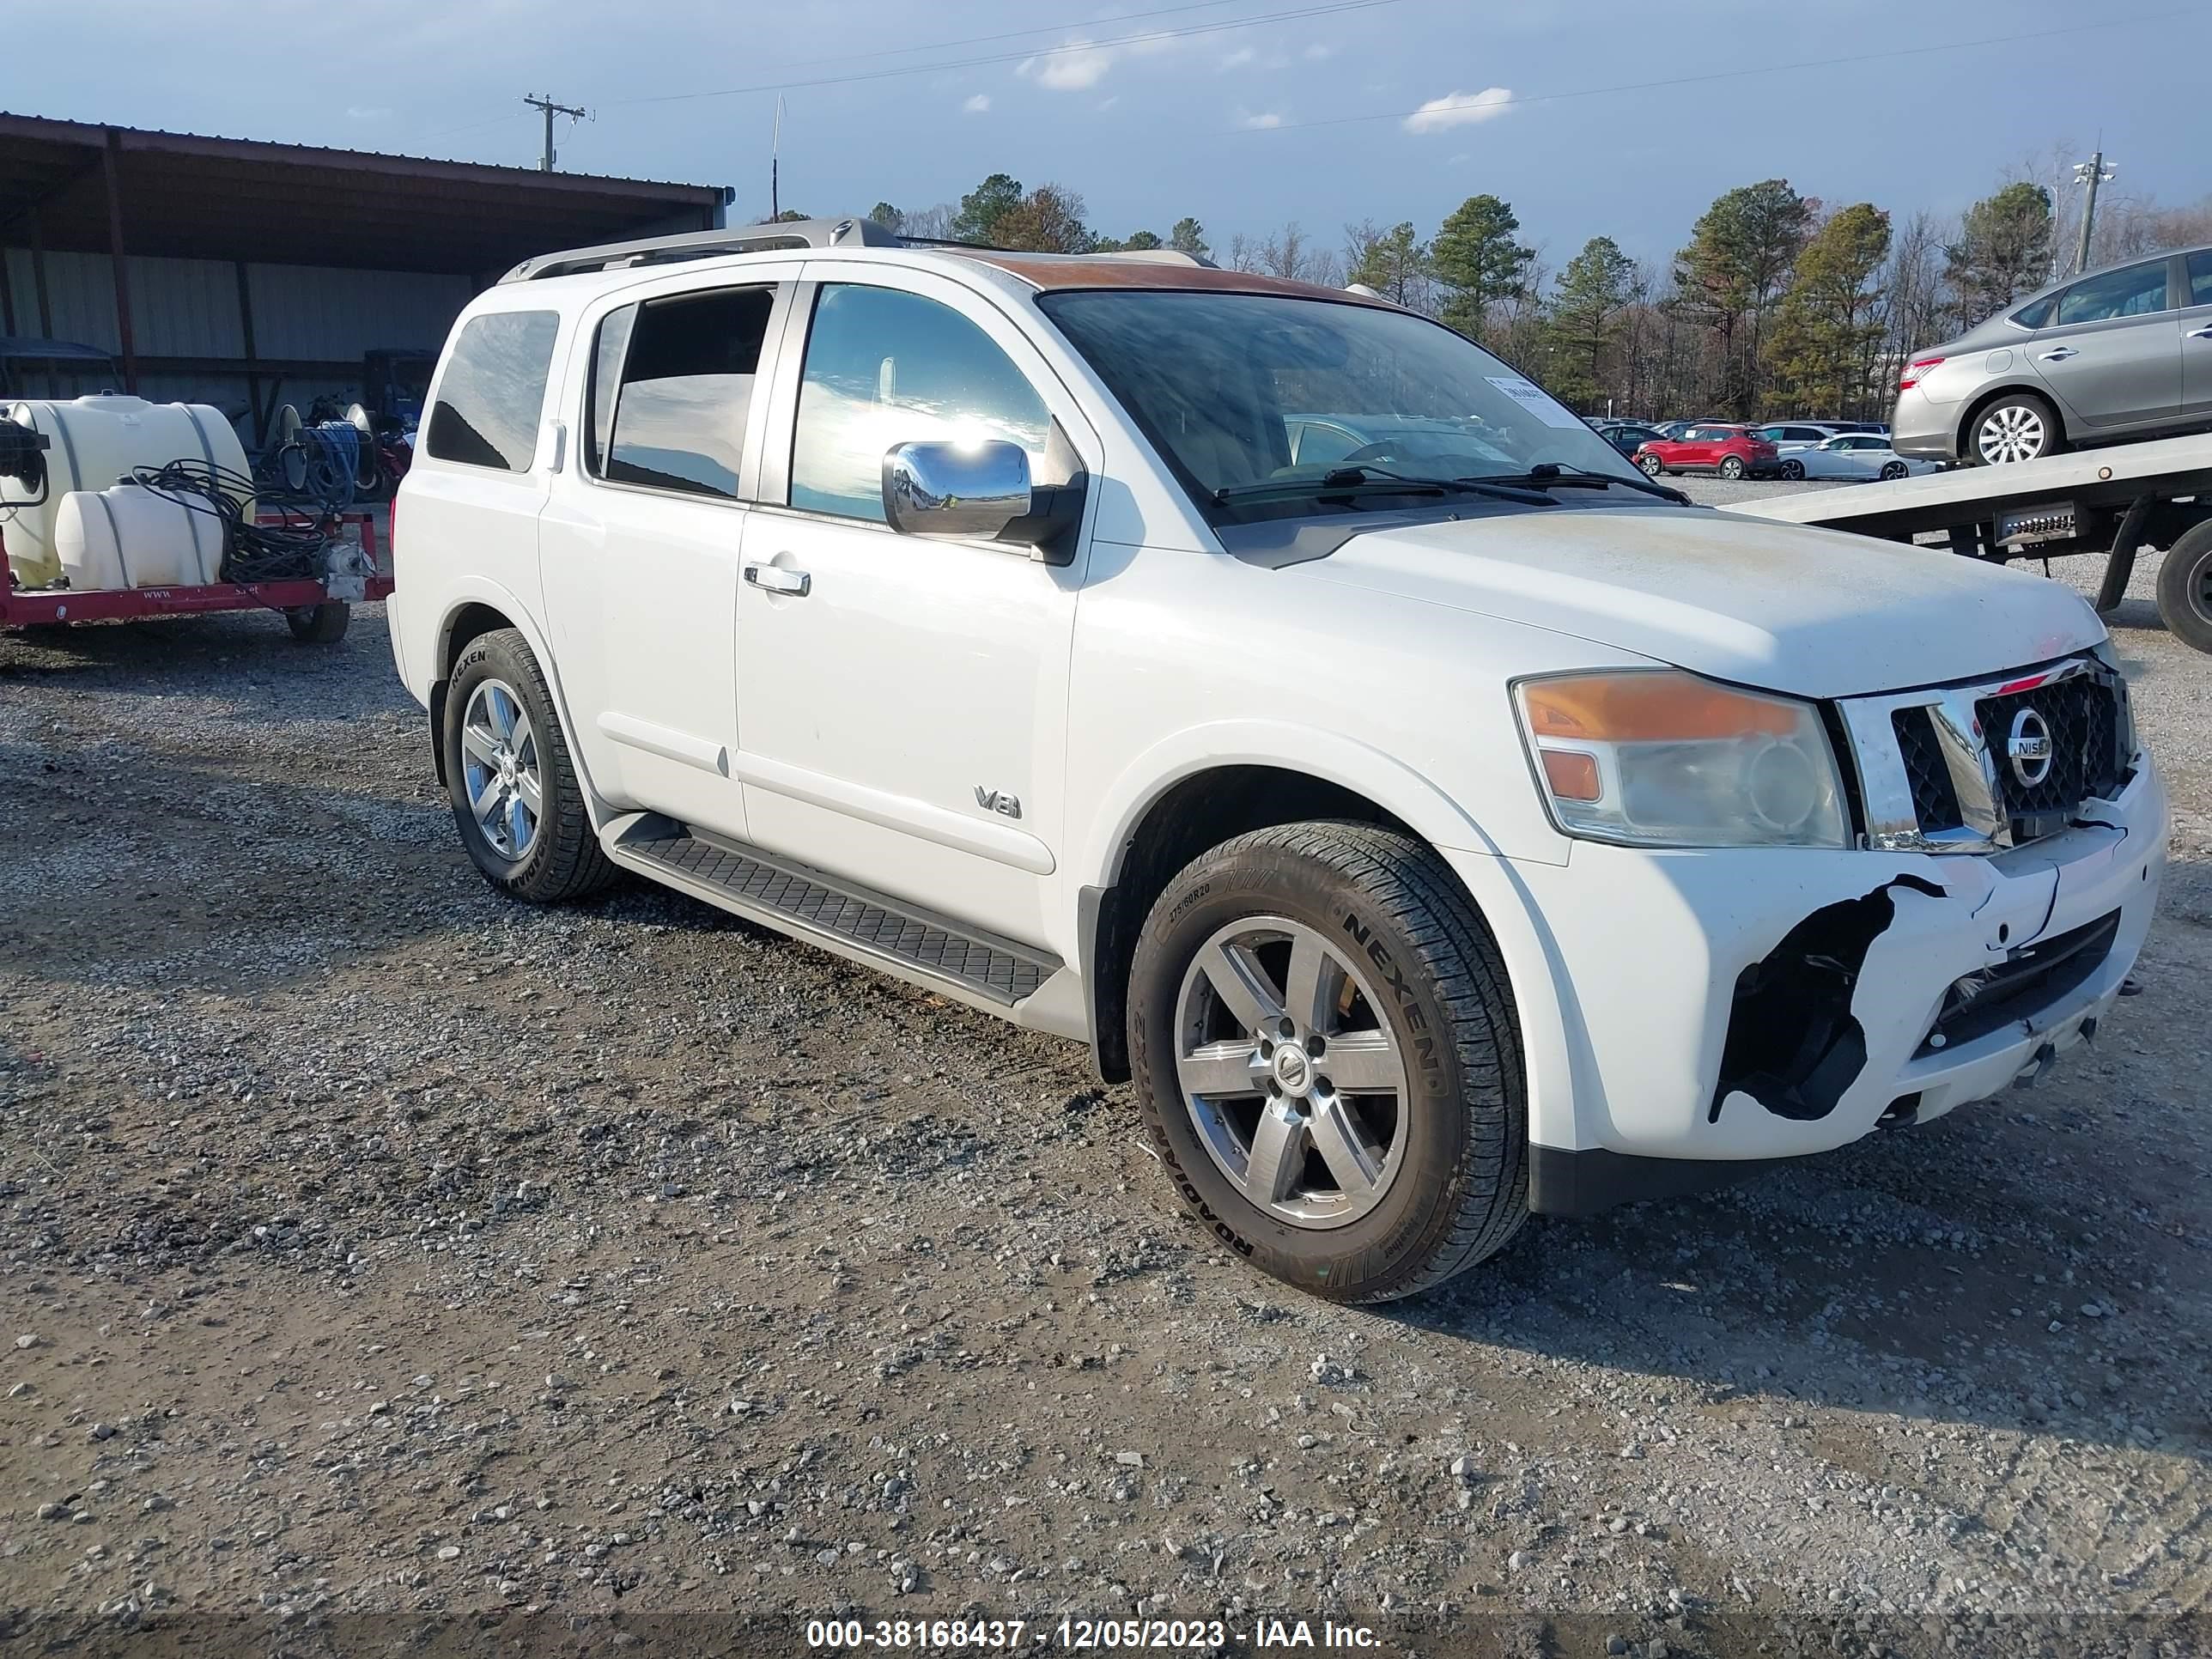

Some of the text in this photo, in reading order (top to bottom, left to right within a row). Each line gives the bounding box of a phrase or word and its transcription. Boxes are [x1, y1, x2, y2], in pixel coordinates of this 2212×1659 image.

[452, 650, 486, 690] NEXEN
[973, 784, 1023, 820] V8
[1169, 883, 1210, 923] 275/60R20
[1342, 912, 1439, 1071] NEXEN
[1151, 1123, 1256, 1257] ROADIAN
